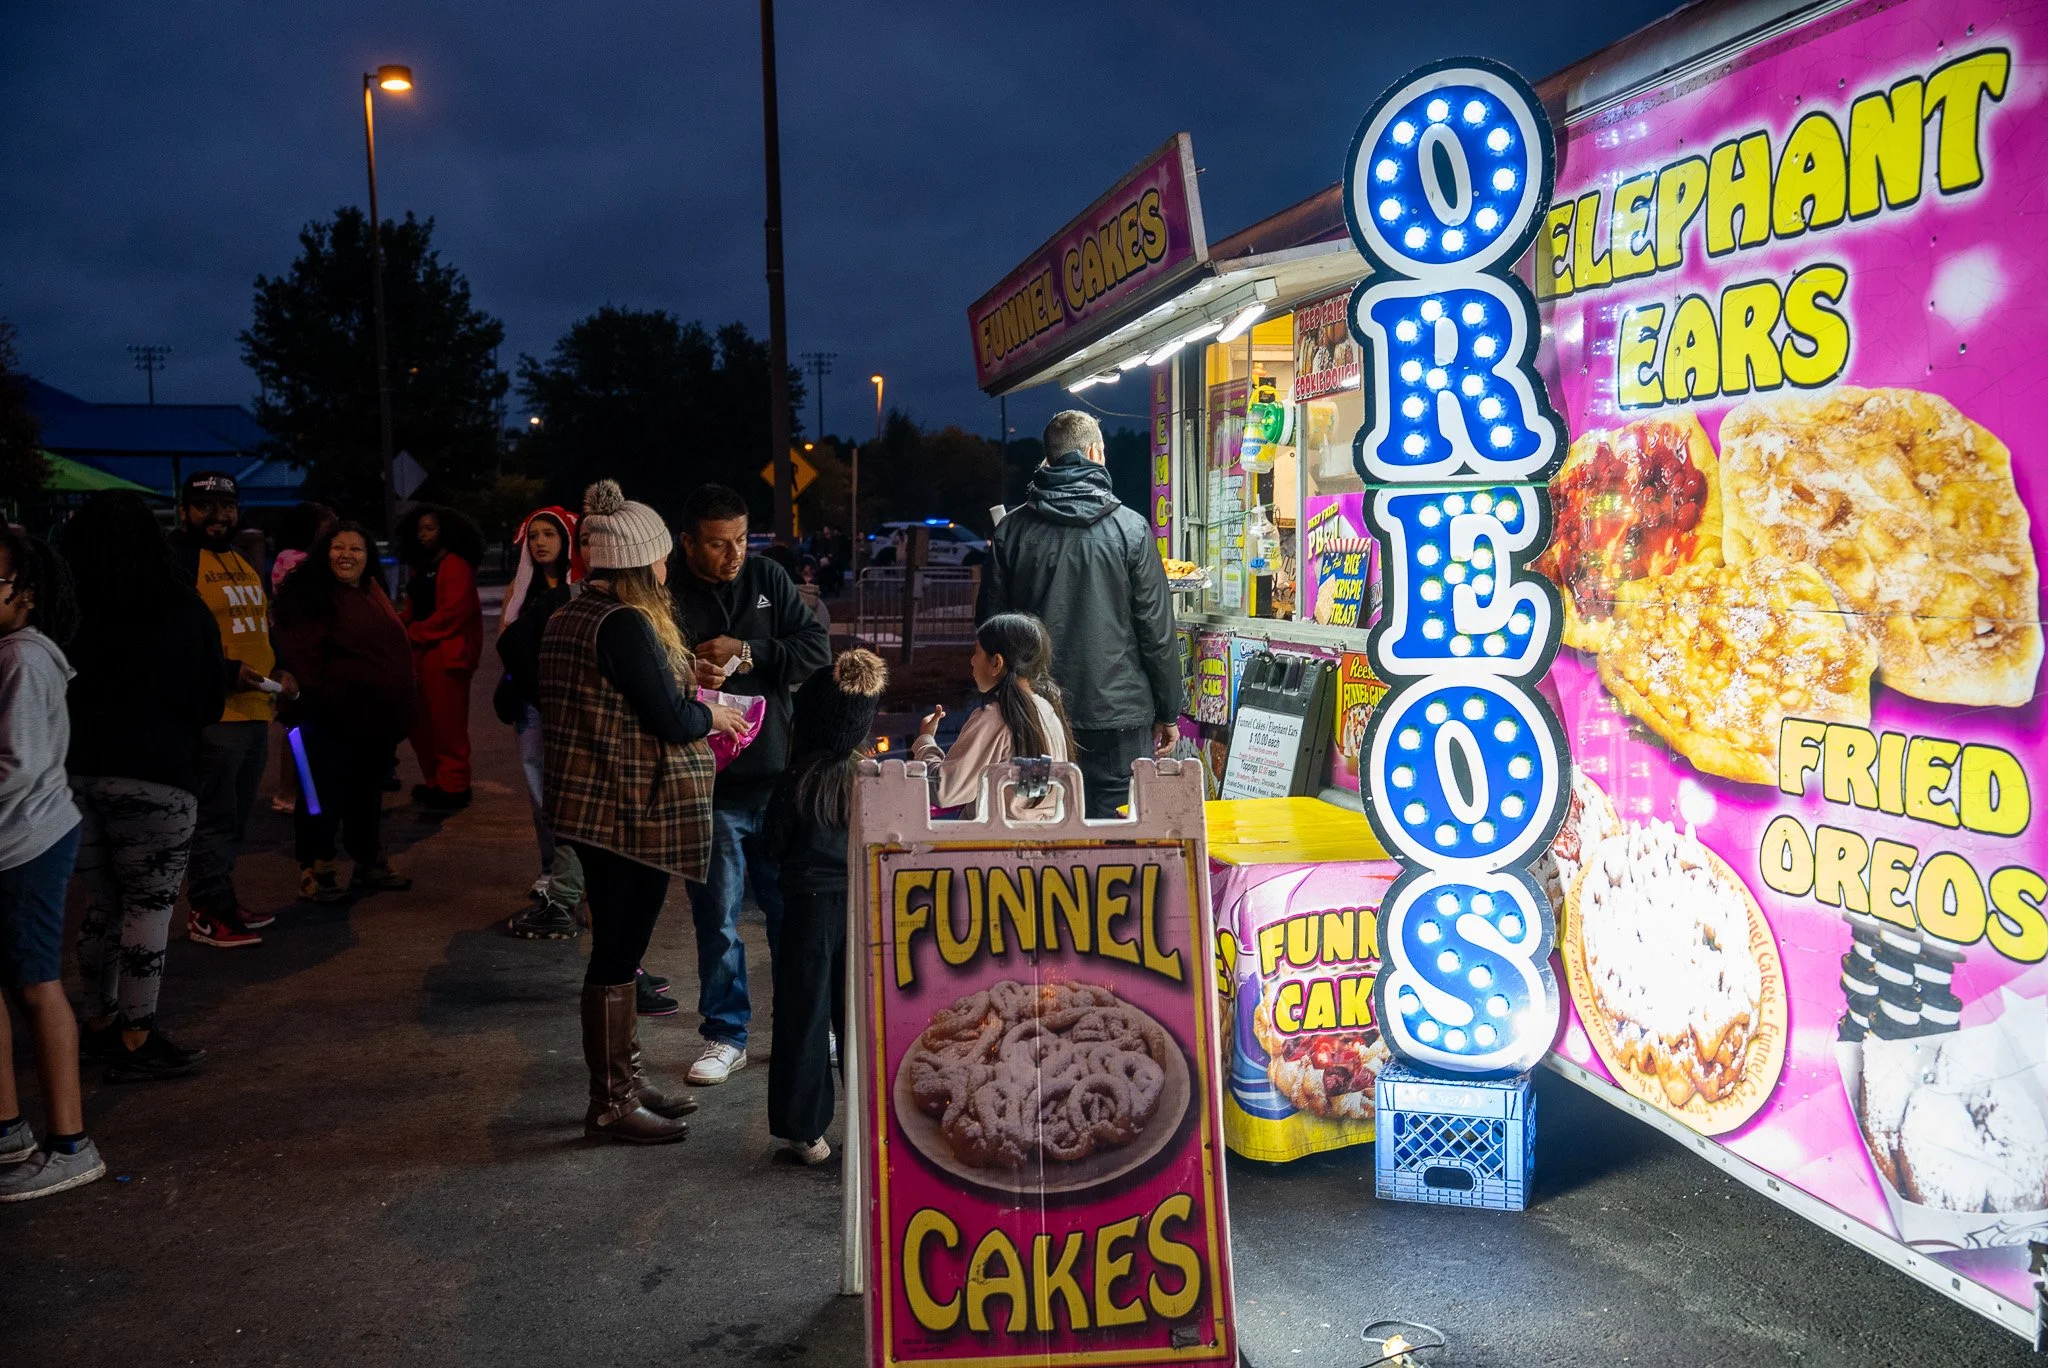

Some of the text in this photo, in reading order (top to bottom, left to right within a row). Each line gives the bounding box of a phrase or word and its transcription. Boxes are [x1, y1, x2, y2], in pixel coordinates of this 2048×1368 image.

[1534, 46, 2011, 304] ELEPHANT
[979, 187, 1168, 368] FUNNEL CAKES
[1299, 306, 1320, 334] DEEP
[1617, 262, 1850, 411] EARS
[1295, 369, 1325, 398] COOKIE
[1343, 552, 1362, 576] RICE
[1352, 66, 1562, 1069] OREOS
[1333, 578, 1363, 601] KRISPIE
[1329, 603, 1357, 625] TREATS
[1199, 657, 1226, 677] FUNNEL
[1202, 678, 1223, 697] CAKE
[1342, 682, 1369, 713] FUNNEL
[1237, 716, 1251, 728] Funnel
[1252, 719, 1265, 730] Cakes
[1268, 721, 1288, 736] Elephant
[1288, 725, 1298, 737] Ears
[1268, 737, 1280, 748] each
[1241, 760, 1258, 774] Toppings
[1268, 769, 1277, 777] each
[1779, 716, 2030, 838] FRIED
[1760, 814, 2048, 964] OREOS
[893, 863, 1186, 993] FUNNEL
[1750, 1021, 1779, 1083] Funnel
[902, 1191, 1203, 1336] CAKES
